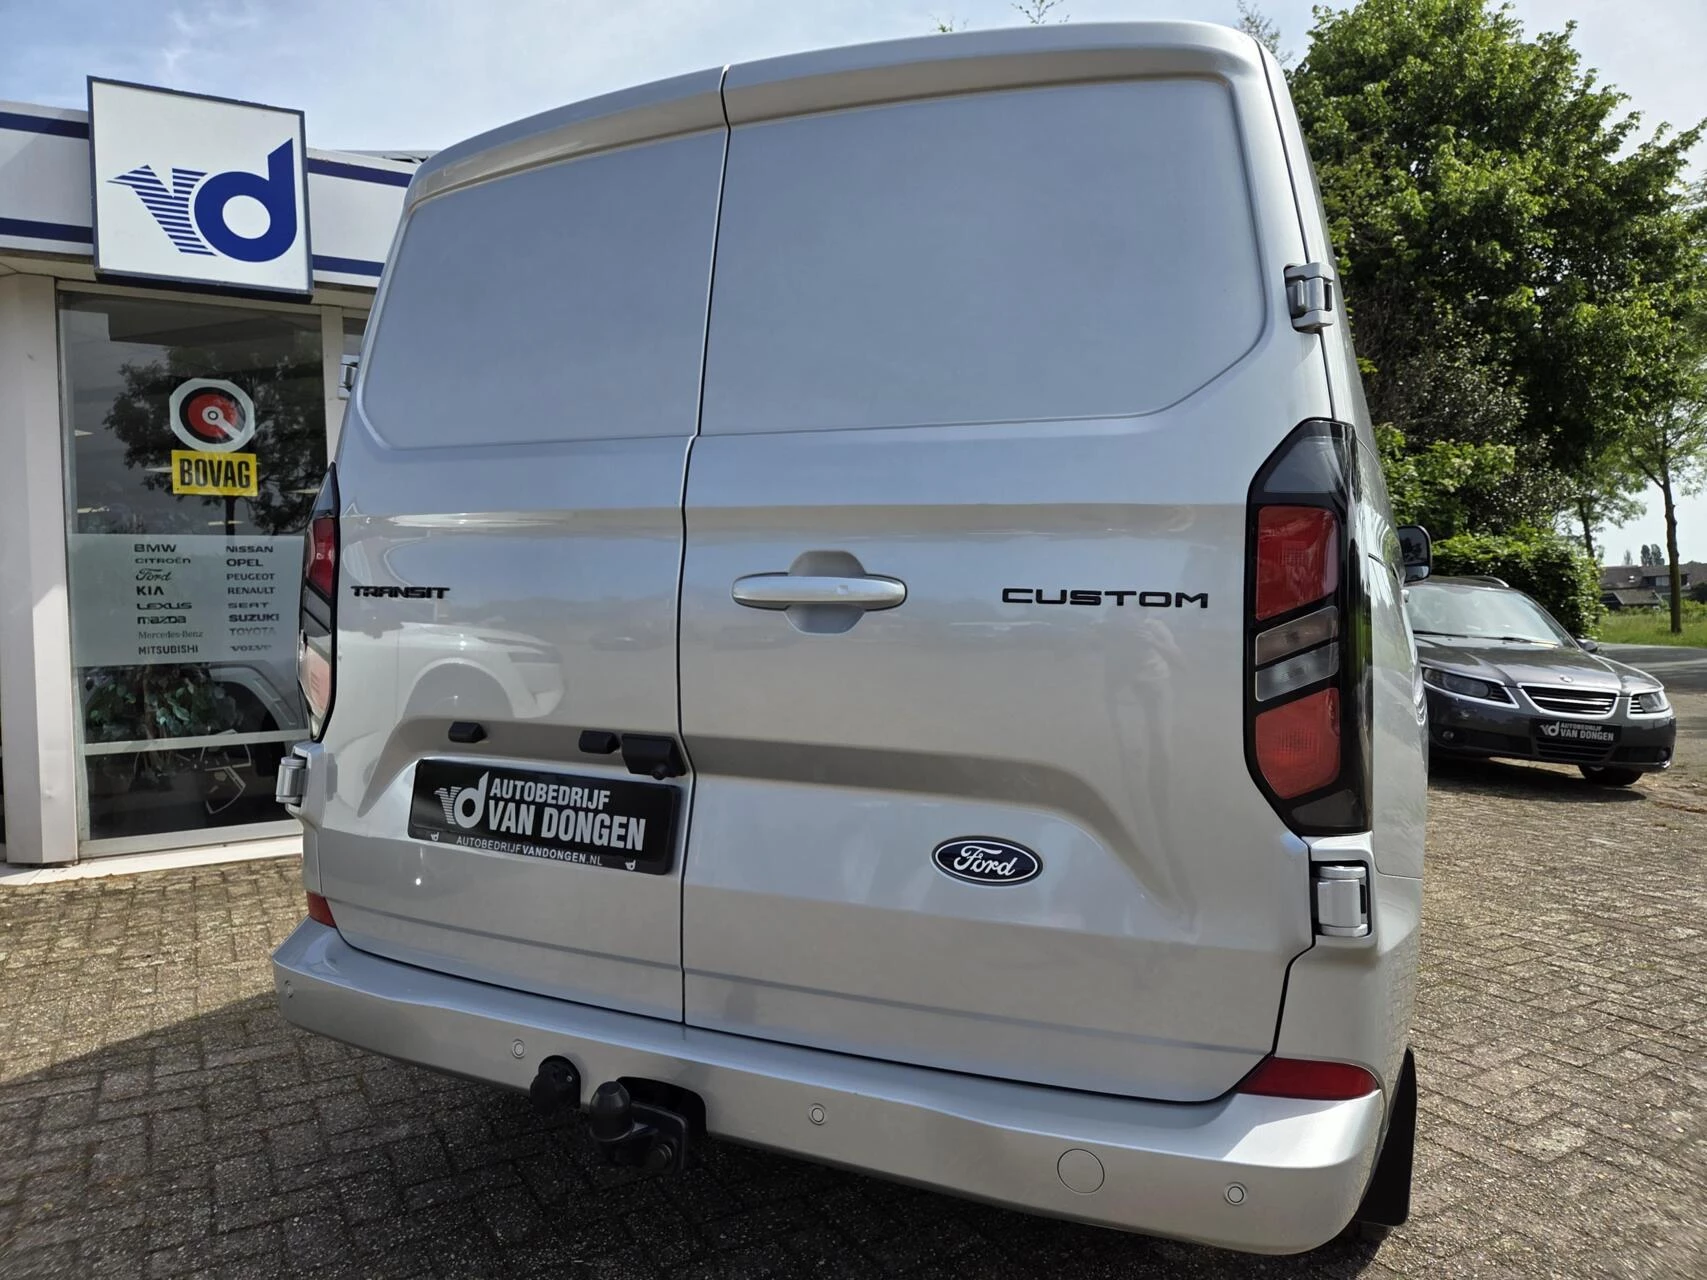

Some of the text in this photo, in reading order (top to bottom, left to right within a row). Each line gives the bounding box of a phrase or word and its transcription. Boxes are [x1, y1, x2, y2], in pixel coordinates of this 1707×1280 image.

[179, 458, 251, 488] BOVAG
[134, 543, 177, 553] BMW
[226, 545, 274, 553] NISSAN
[226, 558, 264, 567] OPEL
[135, 568, 172, 581] Ford
[226, 573, 276, 581] PEUGEOT
[136, 585, 164, 596] KIA
[227, 586, 276, 594] RENAULT
[350, 586, 450, 599] TRANSIT
[1002, 588, 1209, 608] CUSTOM
[136, 602, 193, 610] LEXUS
[228, 613, 280, 622] SUZUKI
[138, 630, 204, 639] Mercedes-Benz
[229, 627, 277, 636] TOYOTA
[138, 644, 199, 655] MITSUBISHI
[1560, 729, 1614, 741] VAN DONGEN
[490, 777, 611, 811] AUTOBEDRIJF
[488, 800, 646, 851] VAN DONGEN
[456, 835, 603, 866] AUTOBEDRIJFVANDONGEN.NL
[953, 845, 1018, 876] Ford
